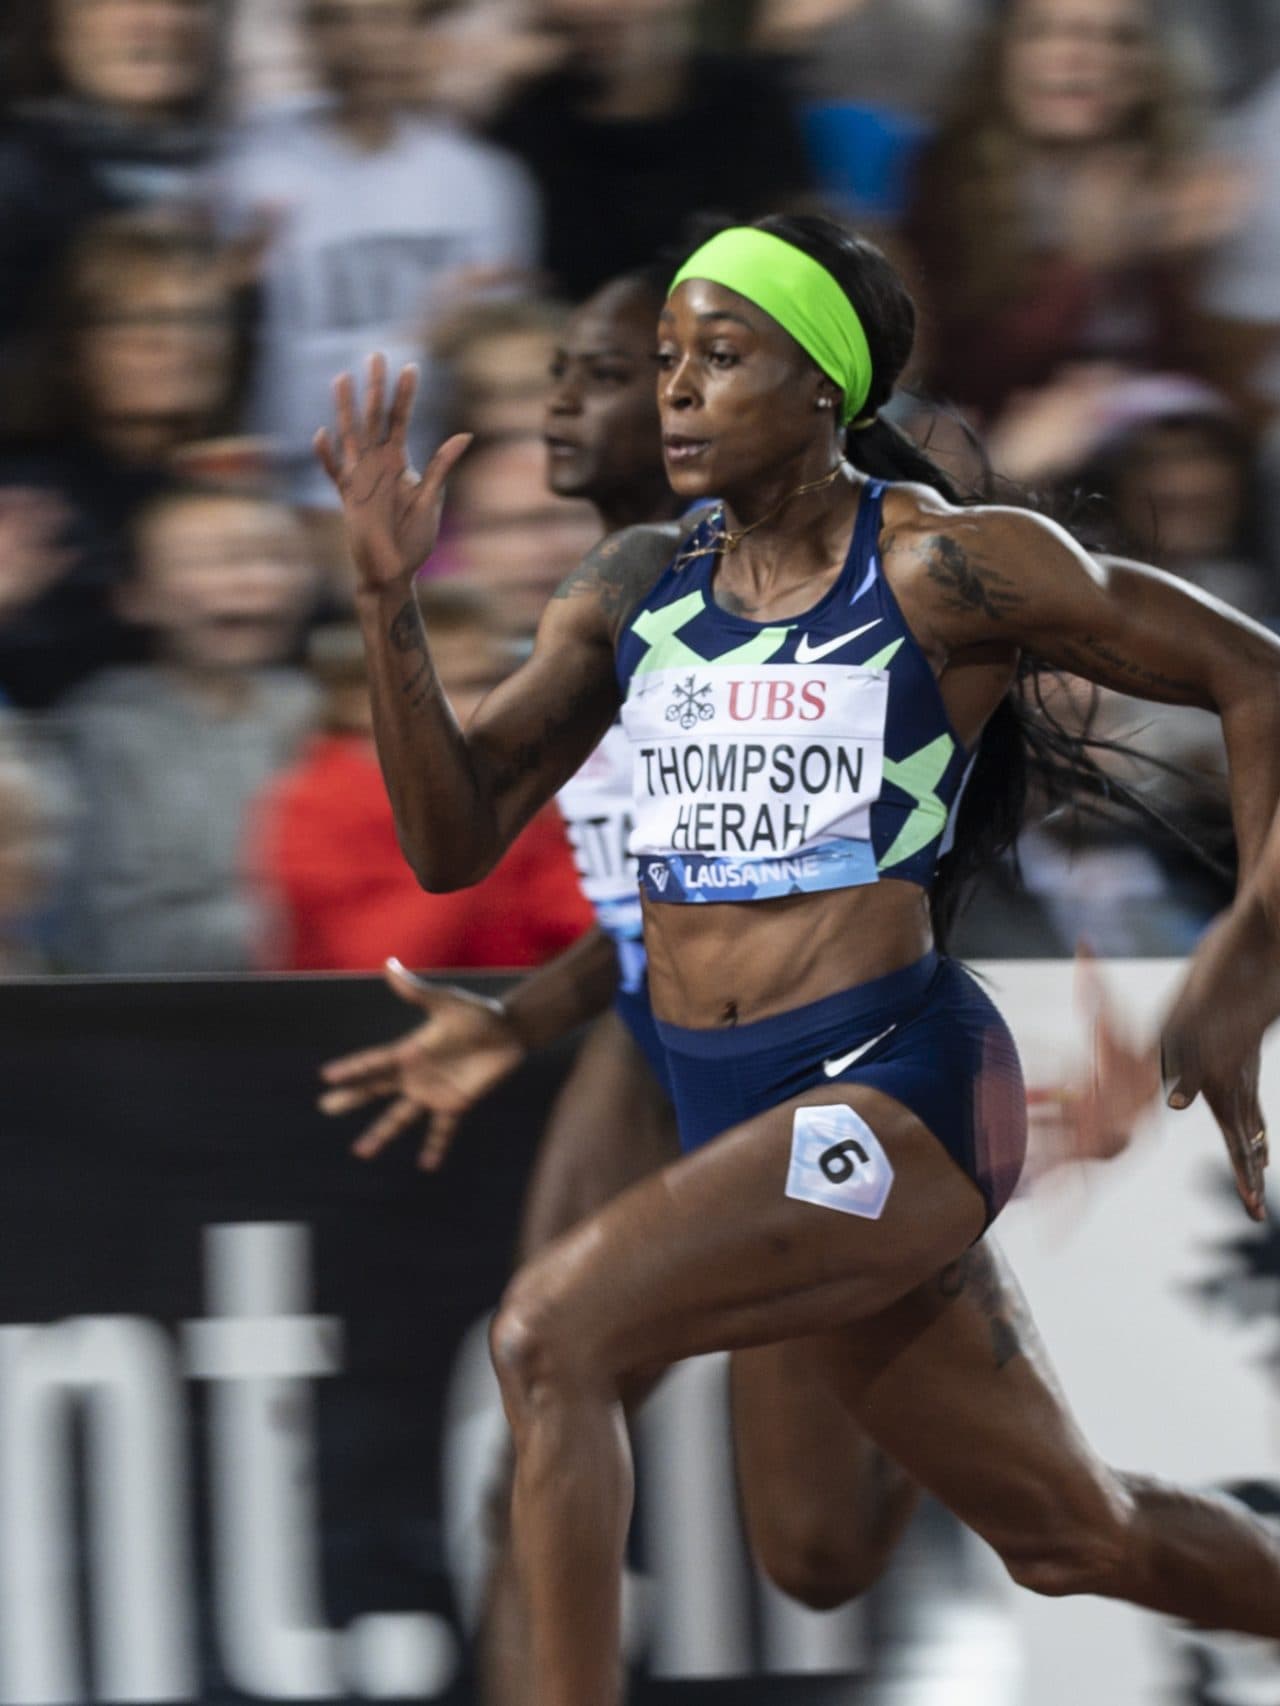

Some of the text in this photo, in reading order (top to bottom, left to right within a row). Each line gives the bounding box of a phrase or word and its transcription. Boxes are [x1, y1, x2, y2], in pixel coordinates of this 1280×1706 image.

[727, 679, 827, 721] UBS
[640, 744, 863, 796] THOMPSON
[671, 802, 810, 852] HERAH
[683, 855, 822, 889] LAUSANNE
[819, 1139, 870, 1184] 6
